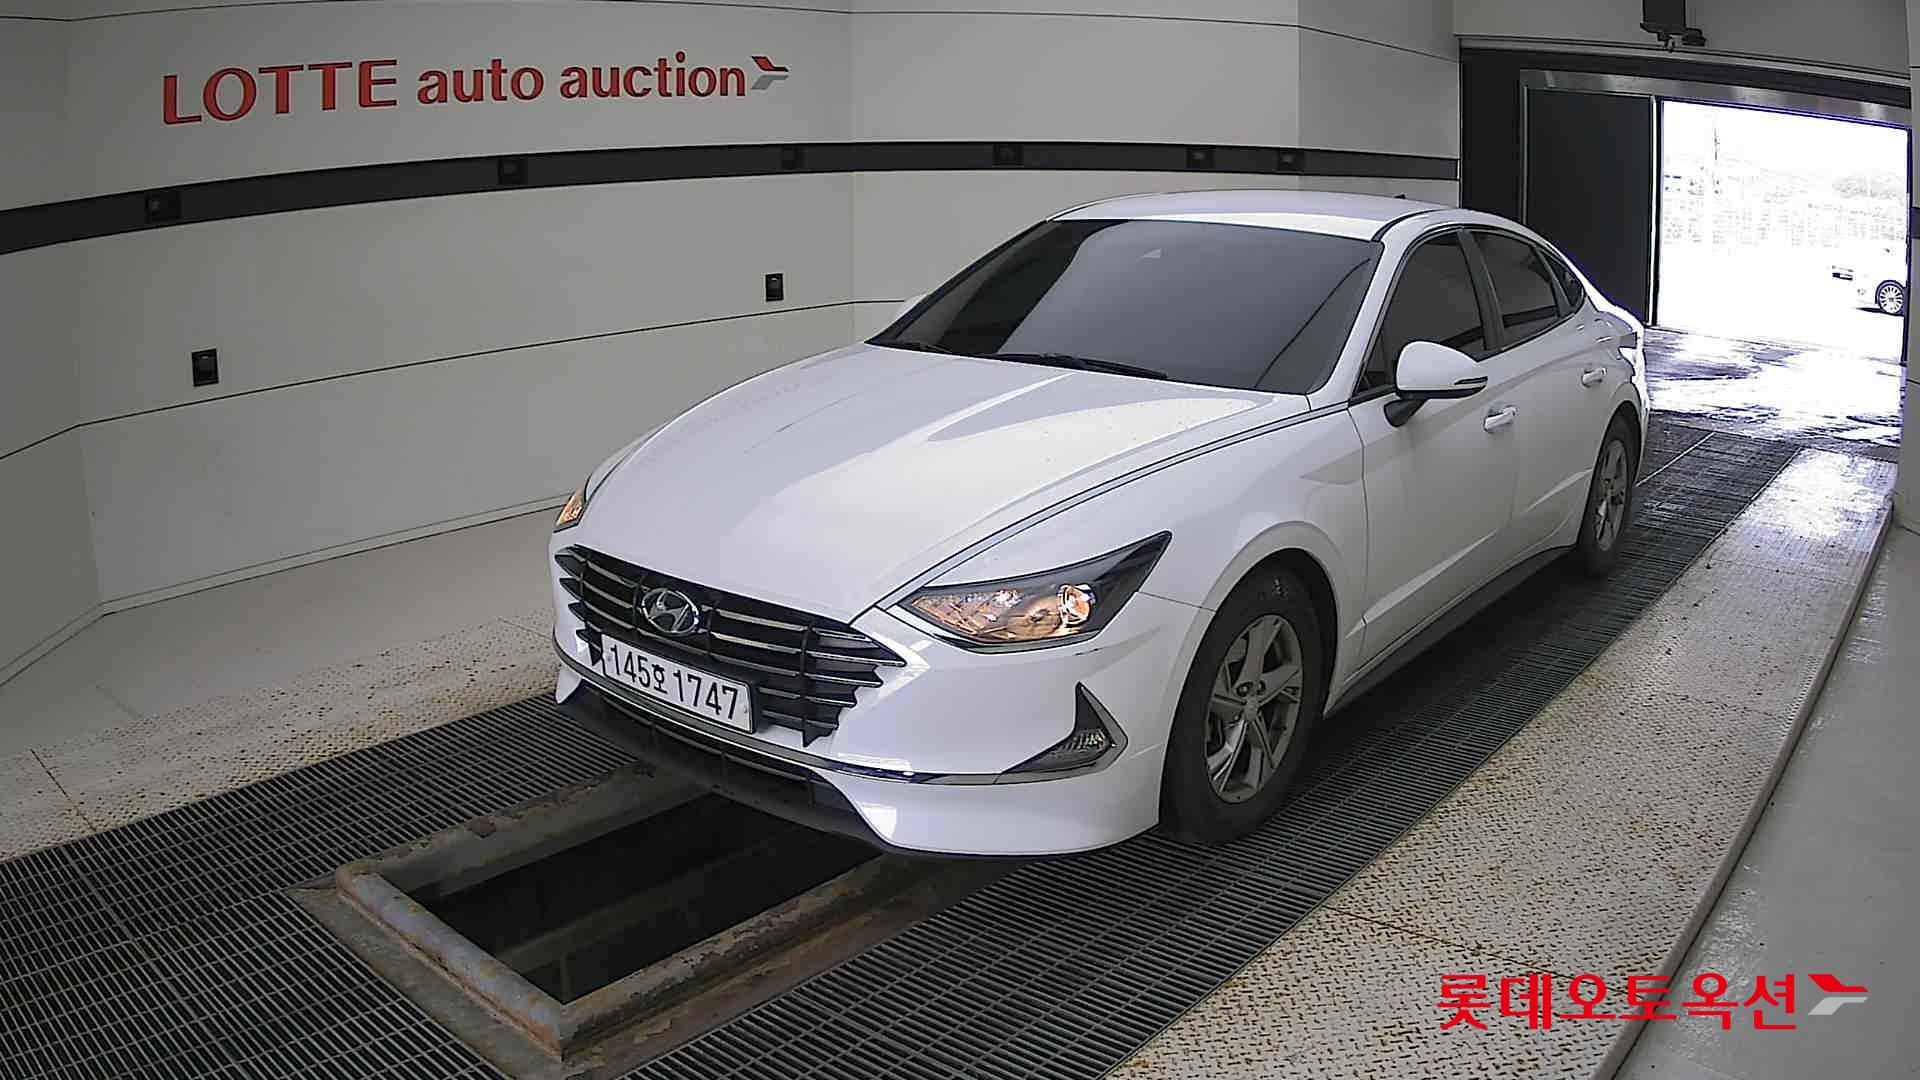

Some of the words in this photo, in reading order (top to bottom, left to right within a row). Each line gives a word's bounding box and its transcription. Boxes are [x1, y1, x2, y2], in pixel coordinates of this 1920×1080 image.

[163, 59, 397, 125] LOTTE
[416, 58, 544, 105] auto
[560, 51, 746, 98] auction
